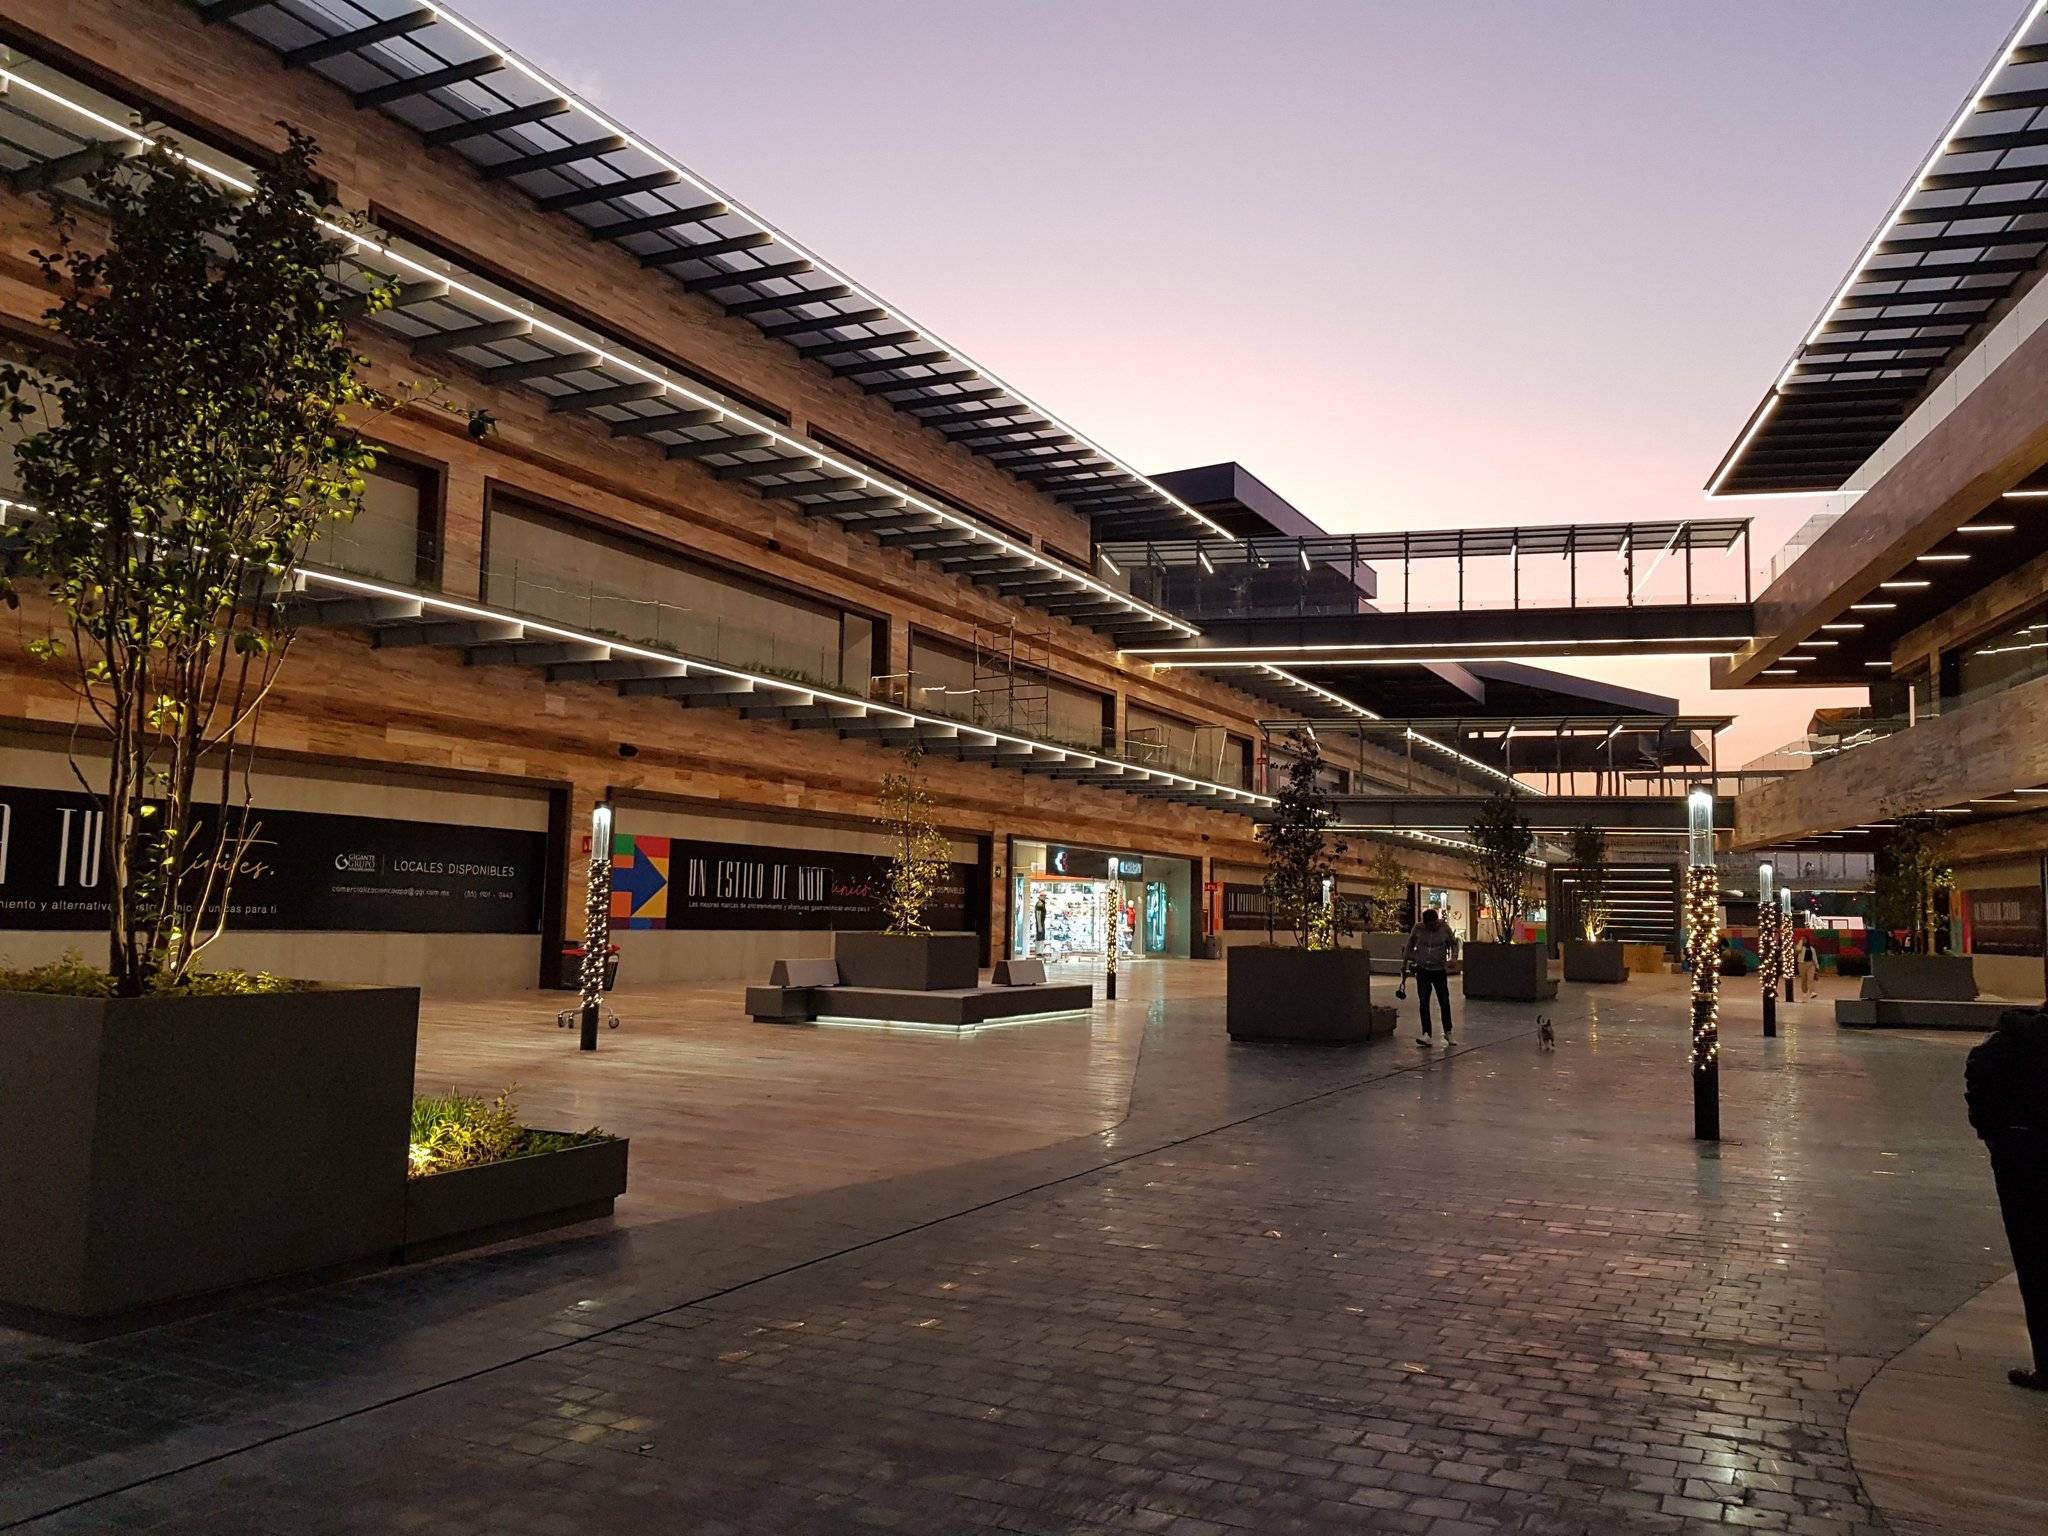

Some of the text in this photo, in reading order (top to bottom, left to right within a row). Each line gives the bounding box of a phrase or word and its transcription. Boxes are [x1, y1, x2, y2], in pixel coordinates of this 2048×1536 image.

[393, 859, 515, 877] LOCALES DISPONIBLES
[688, 858, 707, 897] UN
[717, 860, 764, 899] ESTILO
[773, 864, 788, 900] DE
[40, 902, 48, 912] y
[245, 905, 268, 914] para
